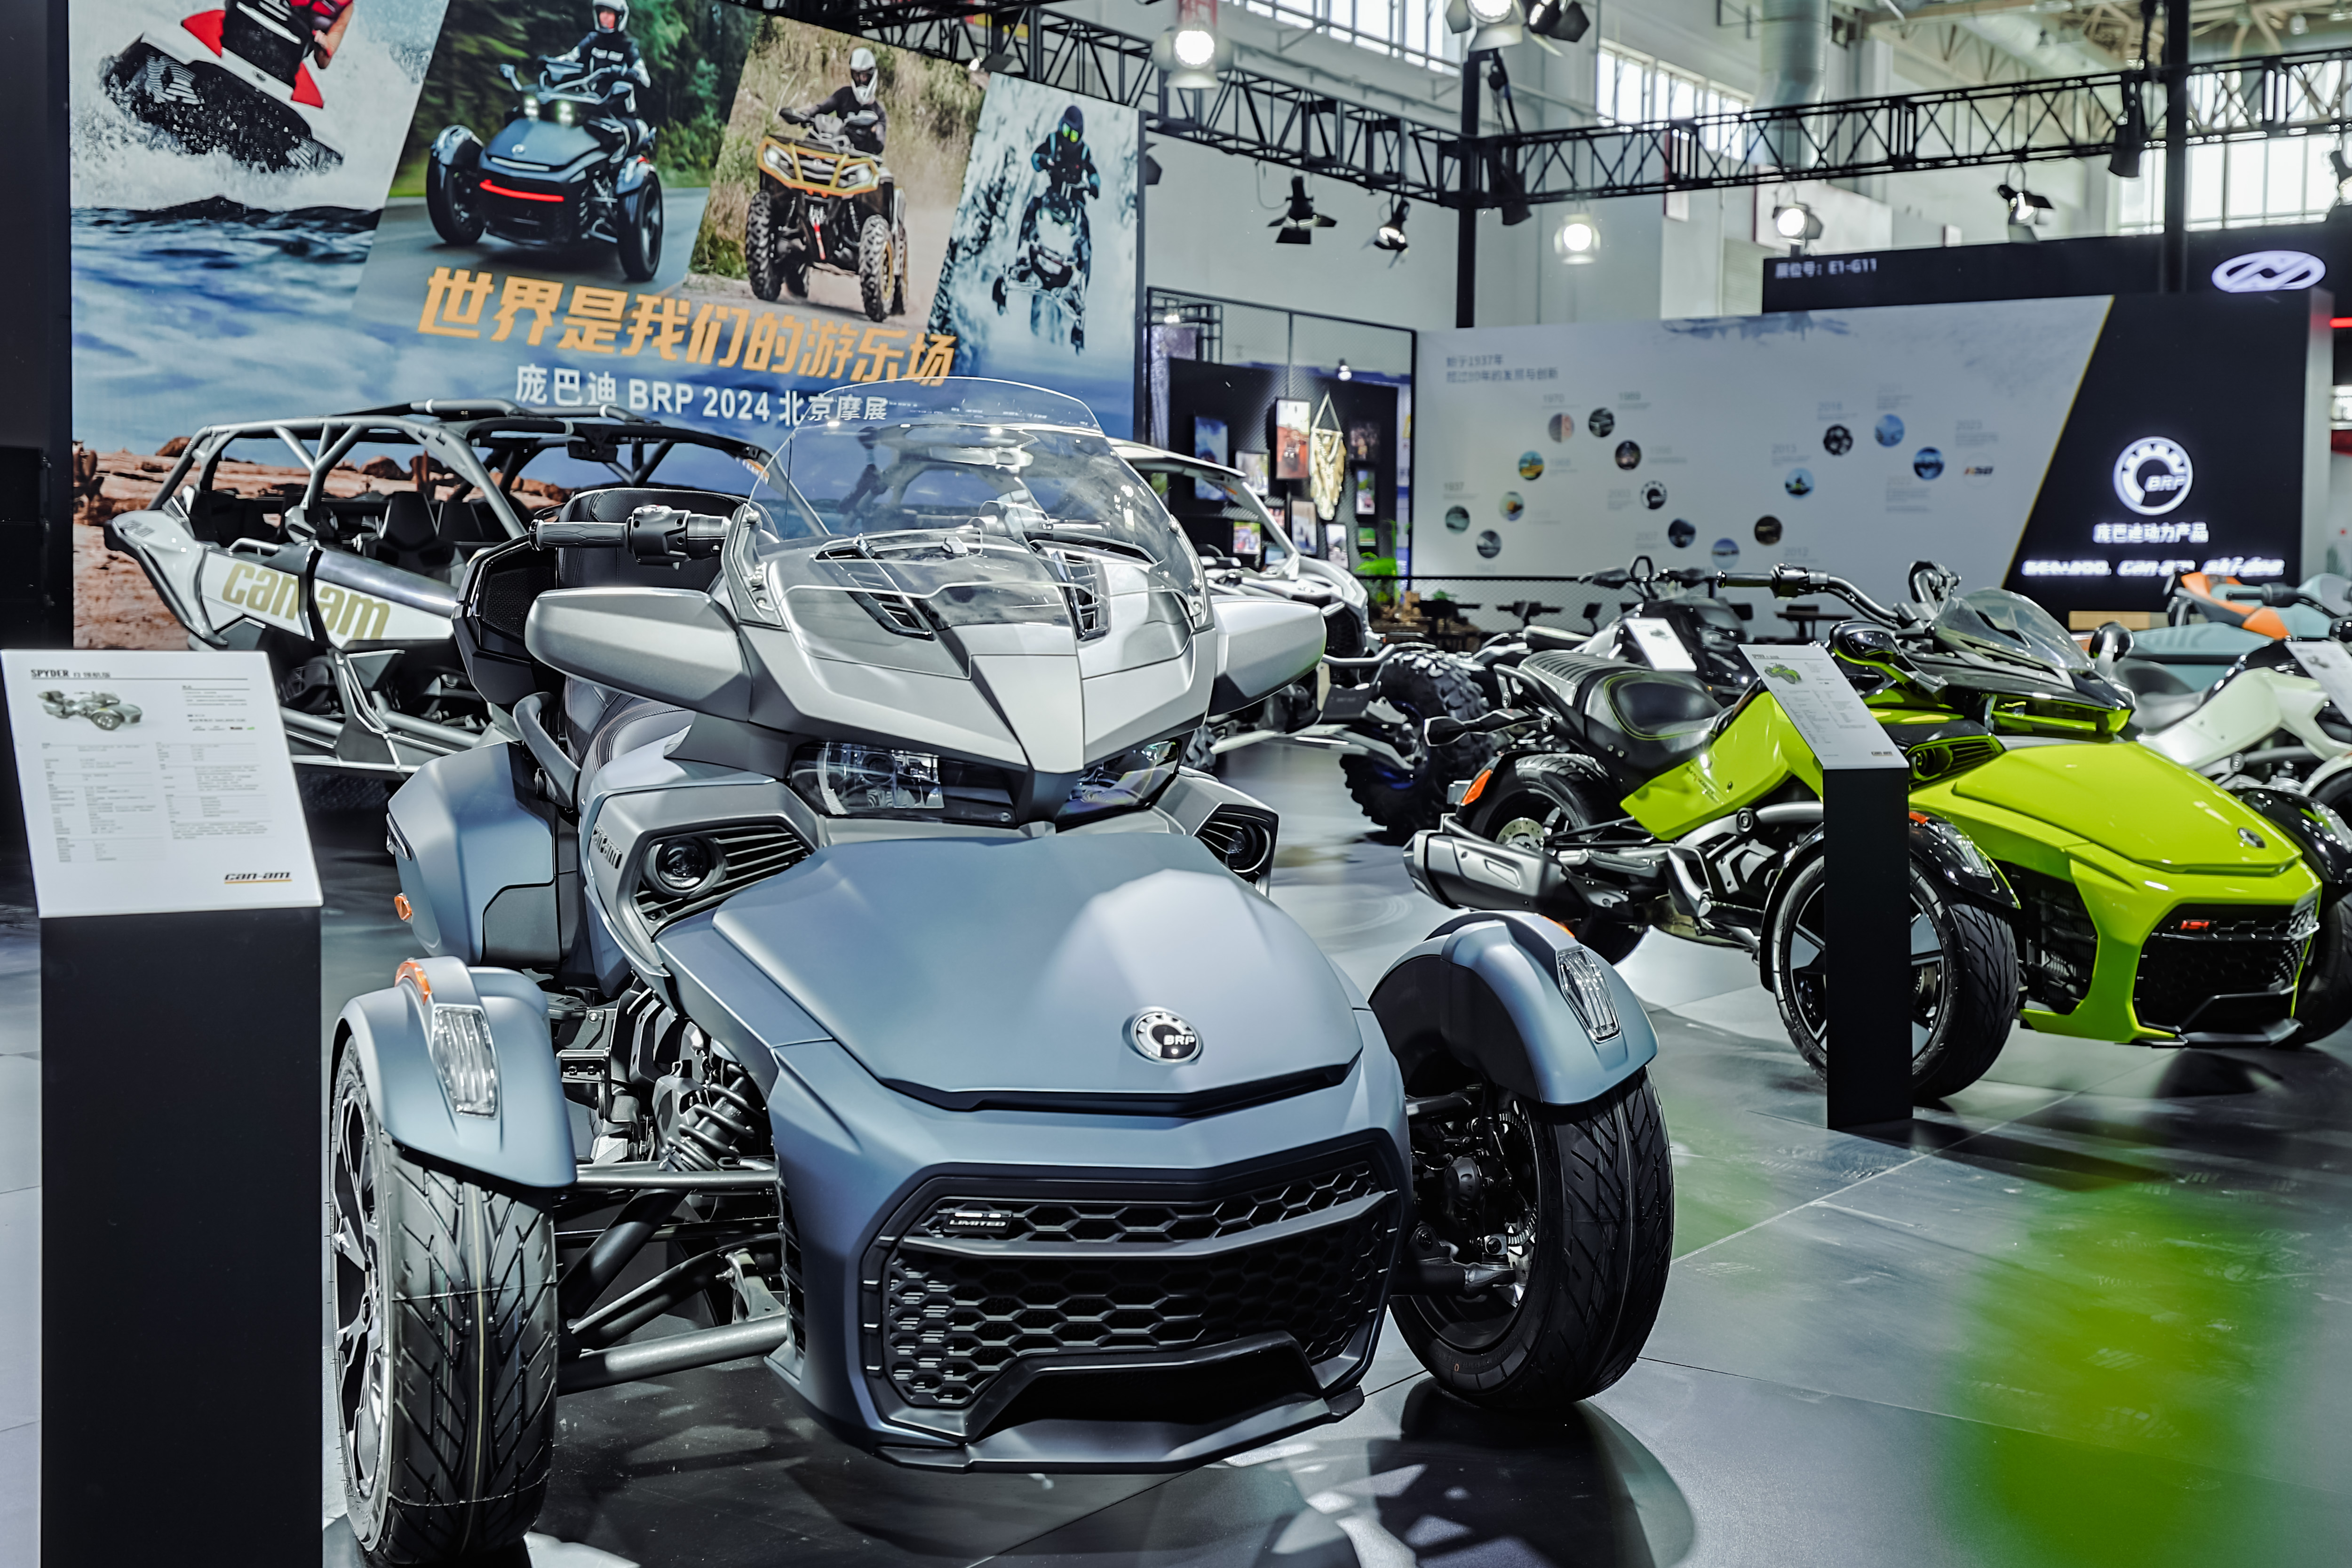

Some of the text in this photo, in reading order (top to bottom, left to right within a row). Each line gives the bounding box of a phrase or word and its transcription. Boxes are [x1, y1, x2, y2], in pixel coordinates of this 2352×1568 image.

[417, 267, 957, 387] 世界是我们的游乐场
[515, 364, 888, 428] 庞巴迪 BRP 2024 北京摩展
[1163, 1035, 1195, 1046] BRP
